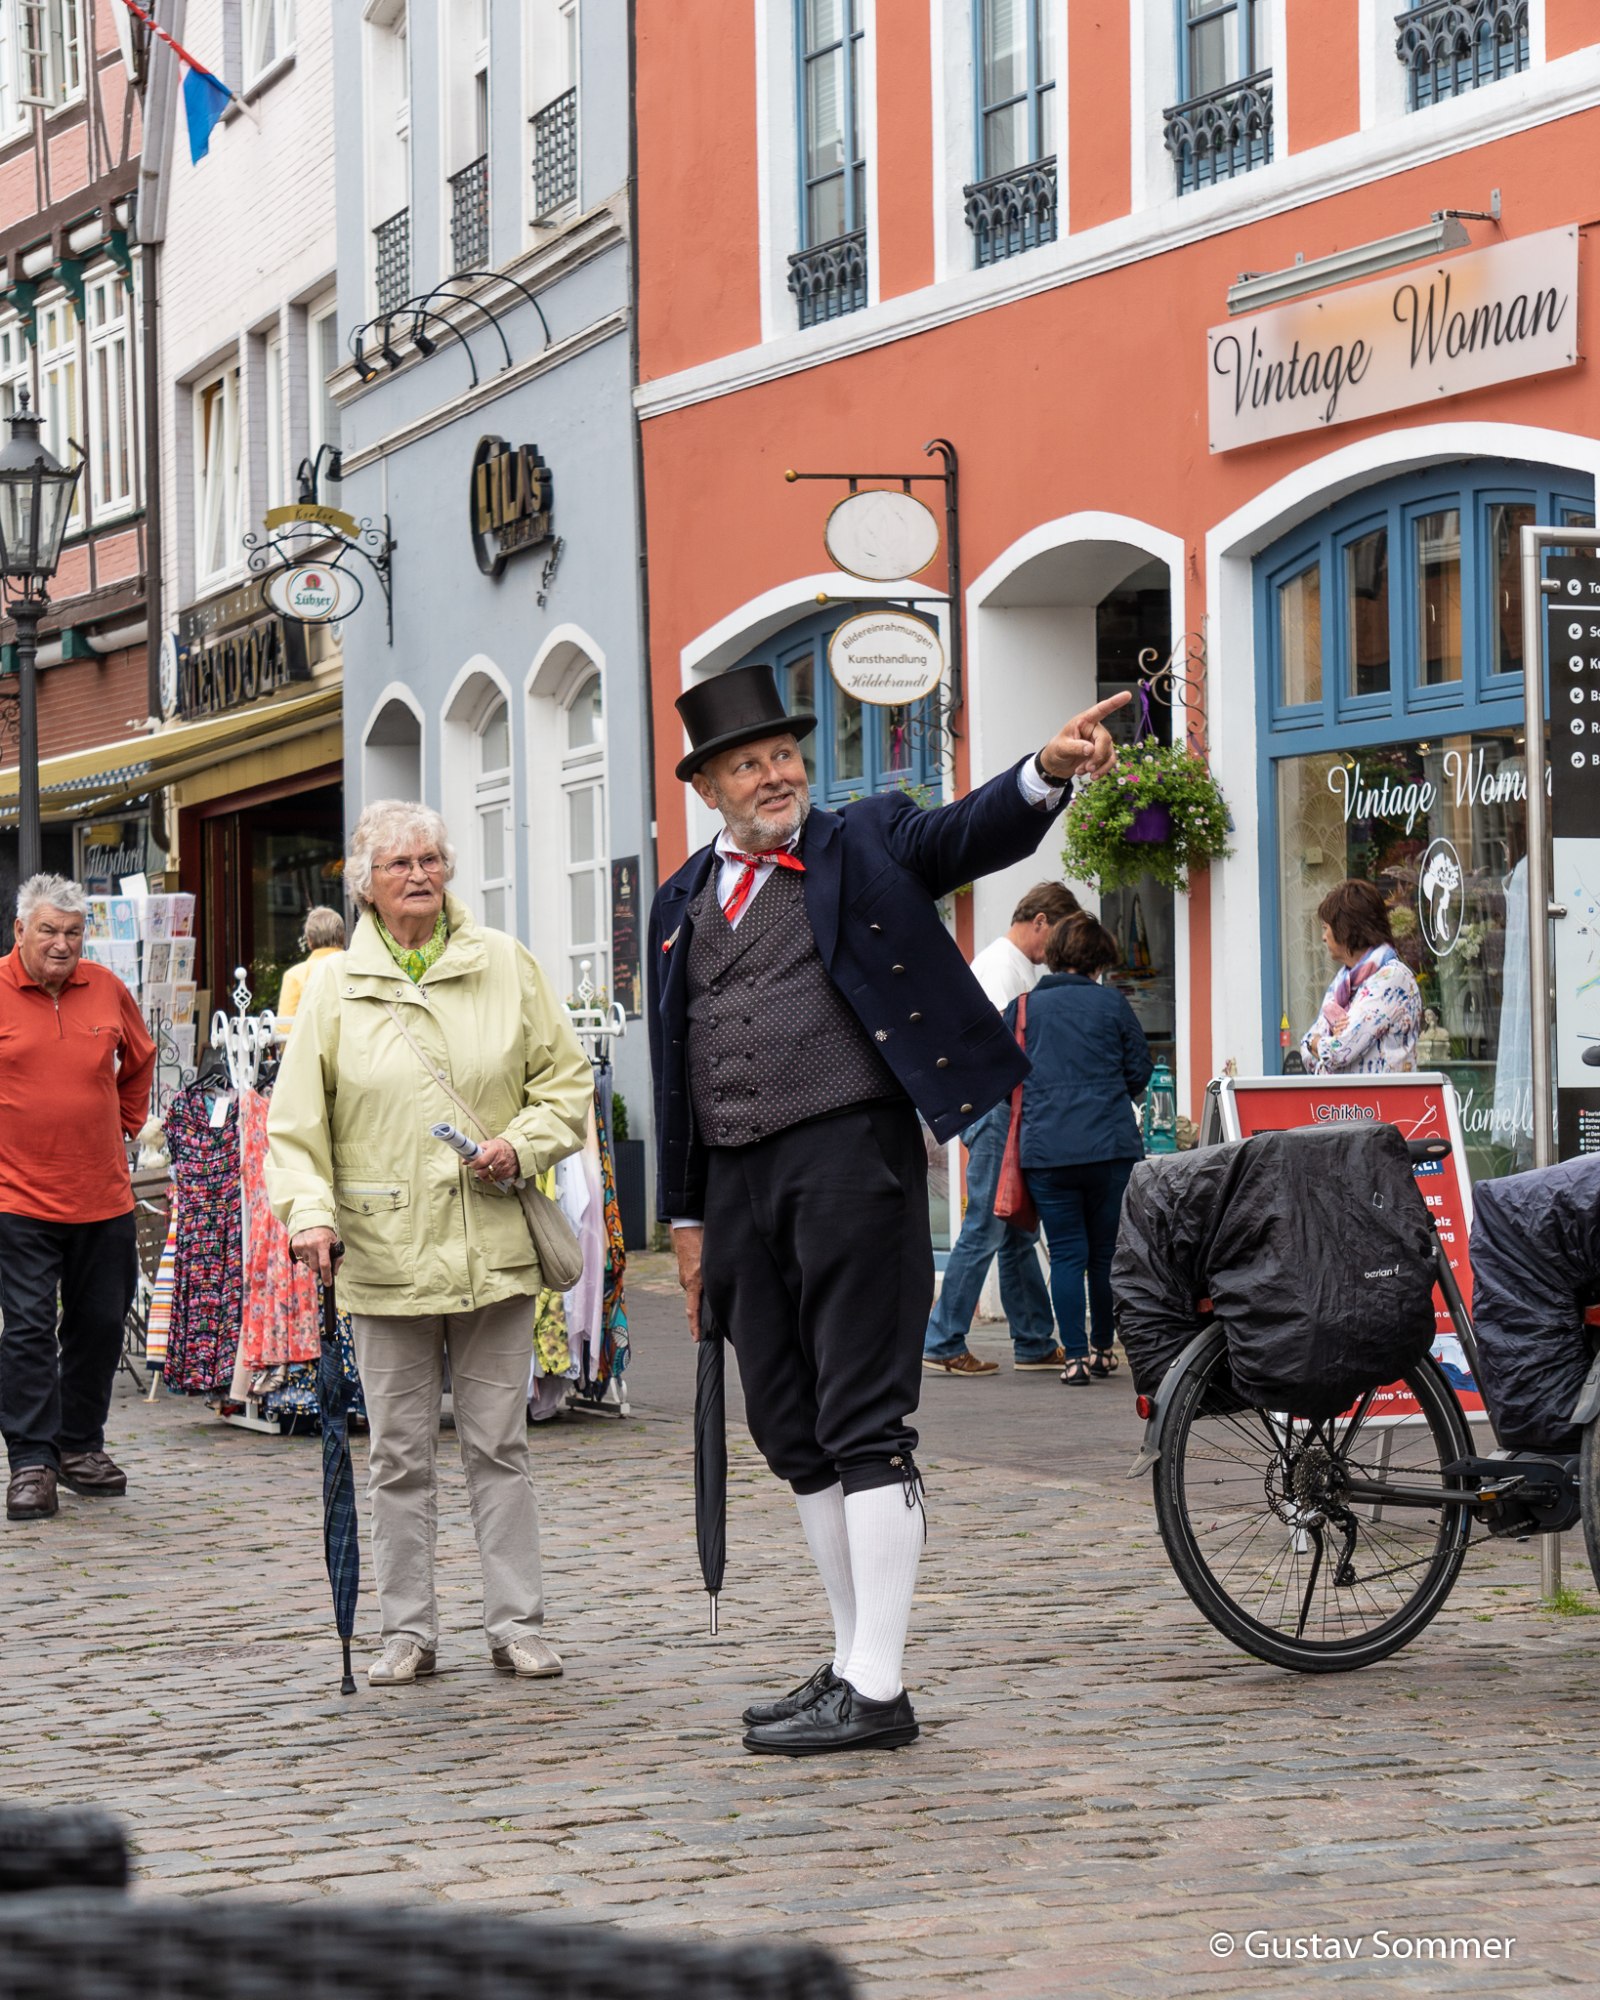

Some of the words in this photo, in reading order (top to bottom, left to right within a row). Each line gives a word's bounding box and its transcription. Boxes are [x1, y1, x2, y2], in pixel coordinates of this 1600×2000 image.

[1213, 325, 1374, 423] Vintage
[1393, 272, 1569, 370] Woman
[294, 593, 331, 607] Lübzer
[188, 586, 266, 637] STEAK-HOU
[841, 622, 934, 650] Bildereinrahmungen
[847, 653, 928, 667] Kunsthandlung
[179, 618, 290, 721] MENDOZA
[846, 673, 930, 689] Hildebrandt
[1327, 763, 1438, 836] Vintage
[1317, 1103, 1376, 1121] Chikho
[1424, 1195, 1443, 1206] BE
[1439, 1232, 1455, 1243] ng
